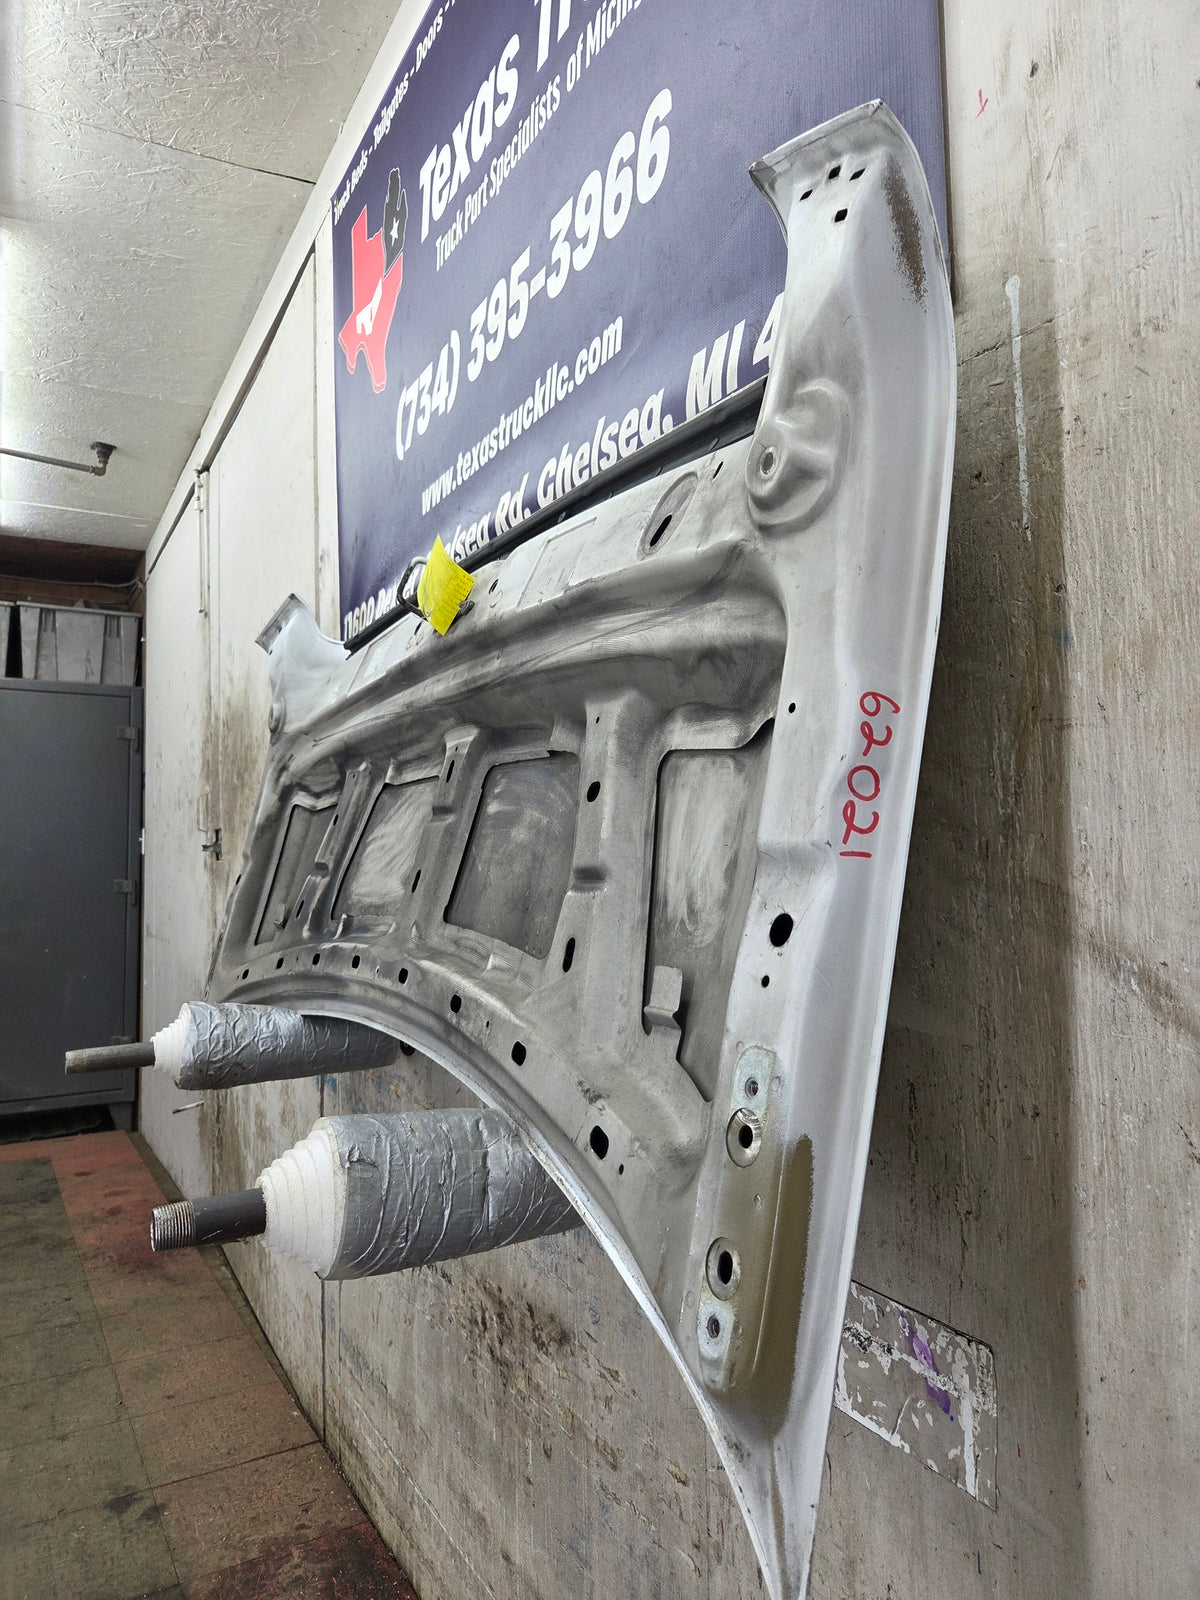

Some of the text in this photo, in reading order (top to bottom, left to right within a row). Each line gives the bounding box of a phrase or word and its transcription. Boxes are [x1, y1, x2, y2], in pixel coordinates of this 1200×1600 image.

[351, 149, 368, 194] Beds
[373, 72, 409, 151] Tailgates
[415, 7, 443, 73] Doors
[418, 33, 520, 244] Texas
[435, 209, 463, 272] Truck
[464, 175, 489, 234] Part
[489, 74, 561, 198] Specialists
[566, 32, 584, 93] of
[395, 88, 673, 460] (734) 395-3966
[685, 318, 746, 421] MI
[421, 315, 623, 516] www.texastruckllc.com
[839, 691, 901, 859] 62021
